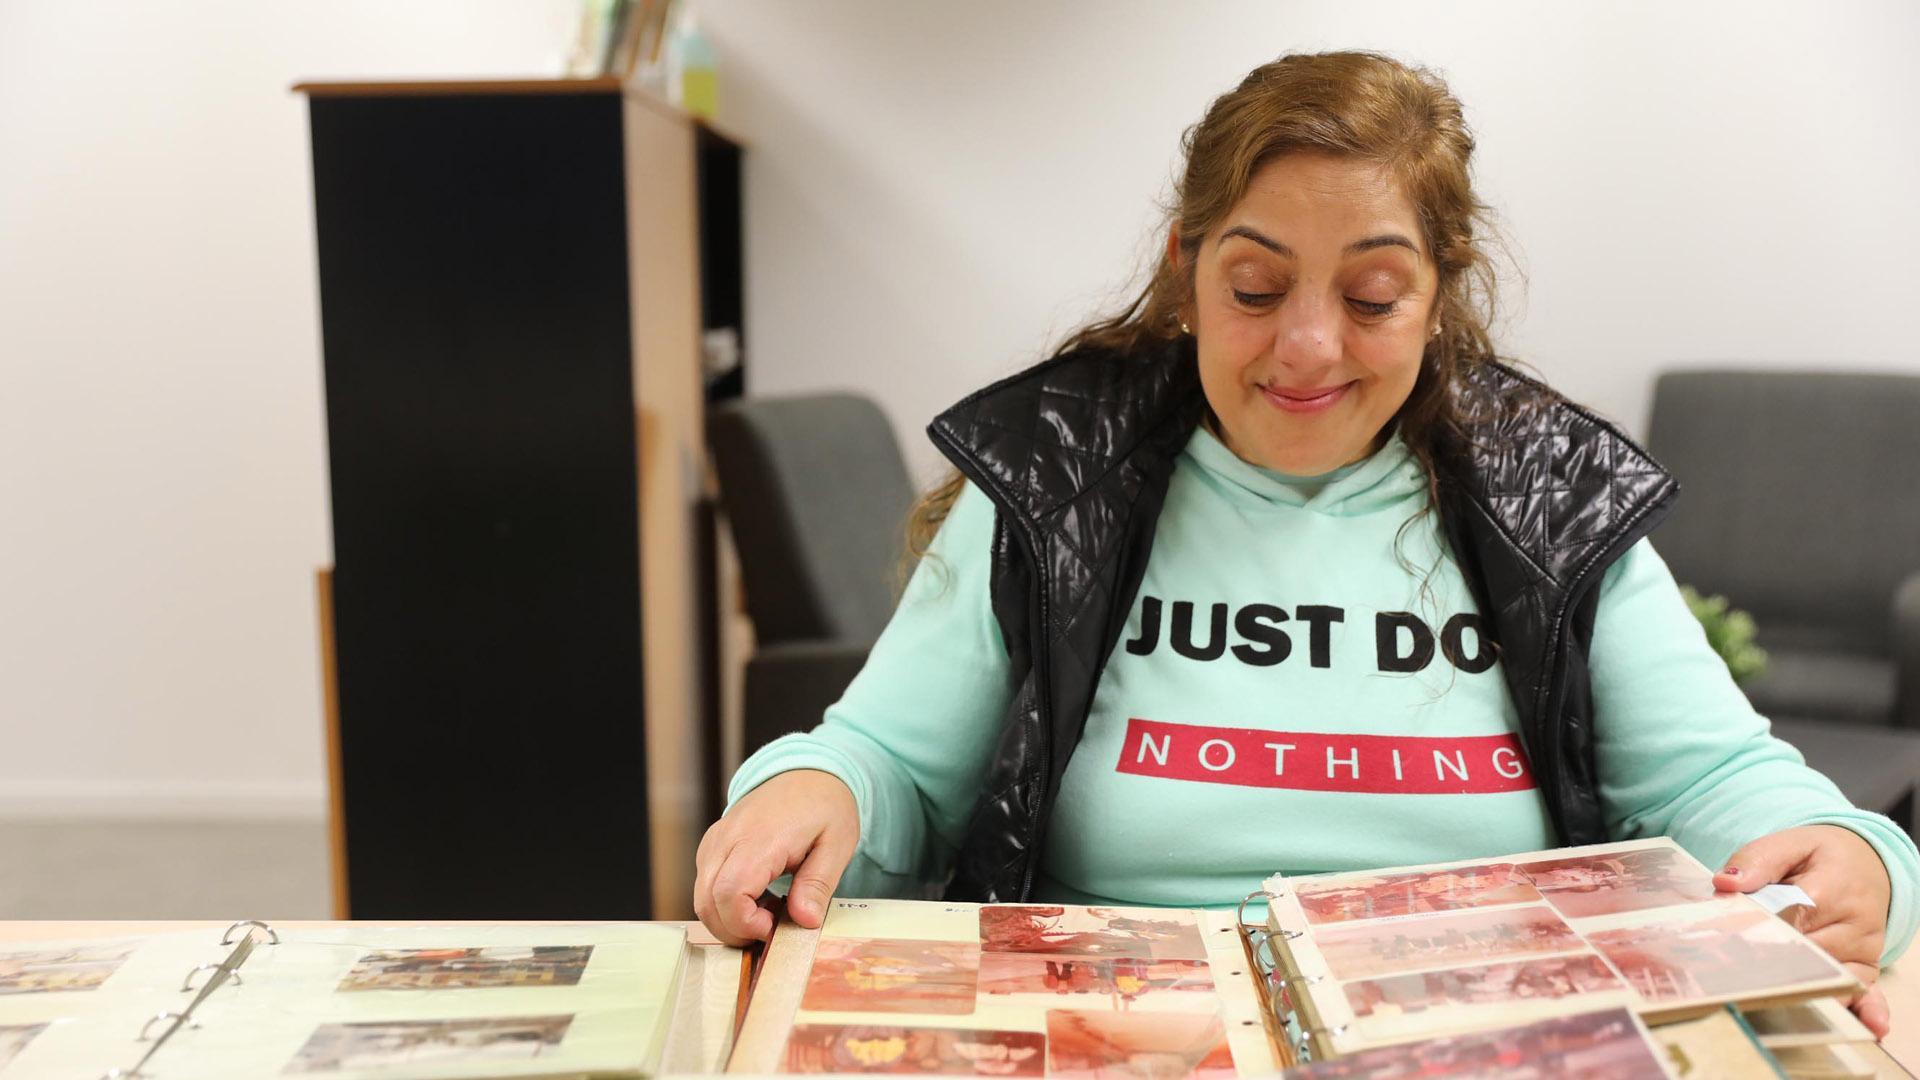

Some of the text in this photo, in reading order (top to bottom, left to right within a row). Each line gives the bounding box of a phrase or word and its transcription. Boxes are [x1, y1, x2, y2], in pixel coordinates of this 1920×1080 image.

[1126, 596, 1500, 674] JUST DO
[1137, 733, 1524, 781] NOTHING
